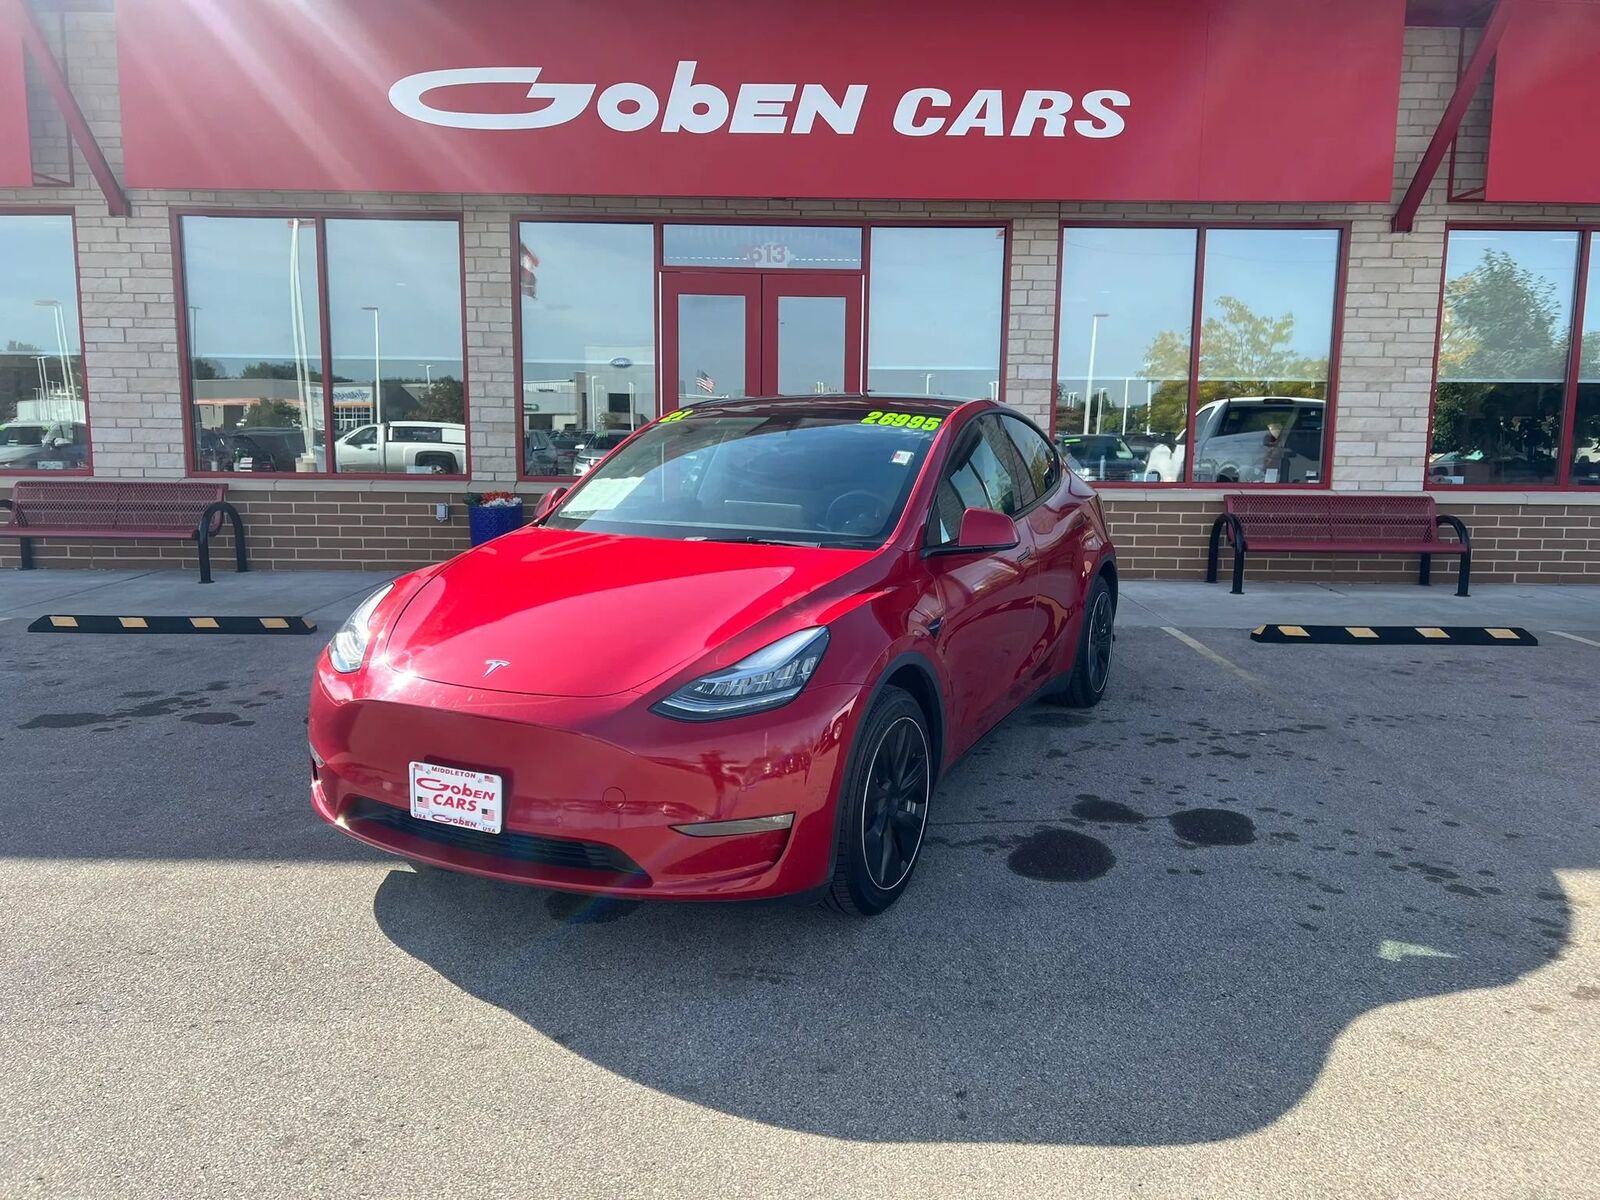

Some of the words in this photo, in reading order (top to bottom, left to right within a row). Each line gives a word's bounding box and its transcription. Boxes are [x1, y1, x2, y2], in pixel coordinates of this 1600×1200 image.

[892, 87, 1131, 138] CARS
[860, 411, 942, 431] 26995
[431, 766, 476, 779] MIDDLETON
[433, 794, 477, 812] CARS
